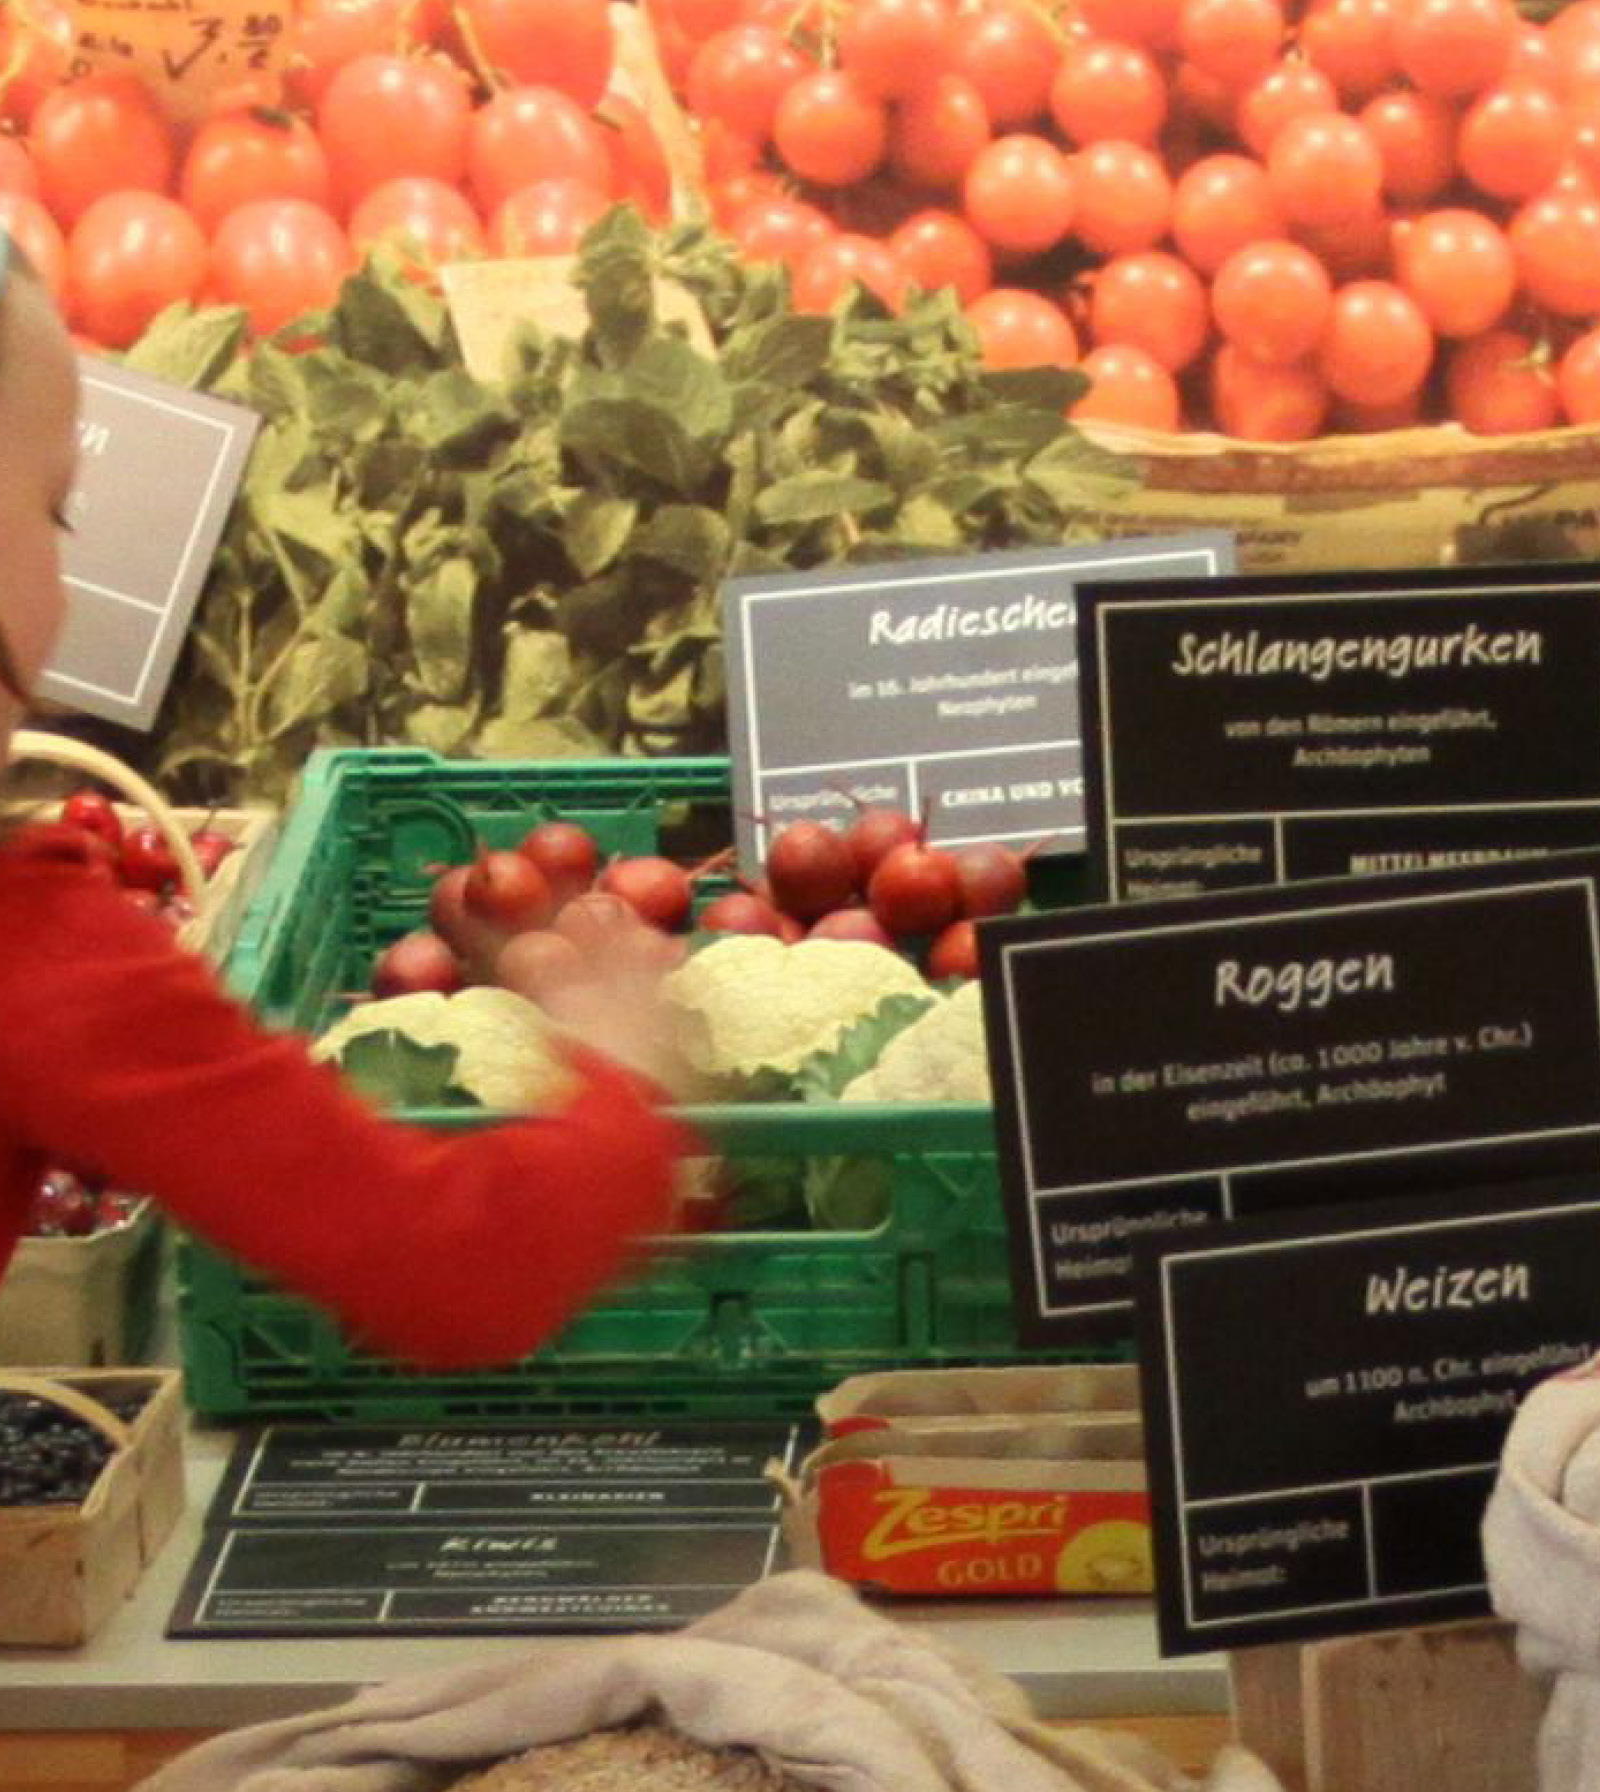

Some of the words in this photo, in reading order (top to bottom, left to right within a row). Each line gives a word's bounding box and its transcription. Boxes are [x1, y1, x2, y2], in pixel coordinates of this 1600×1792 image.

[869, 594, 1077, 646] Radiesche
[1171, 622, 1542, 682] Schlangengurken
[940, 784, 1005, 808] CHINA
[1009, 781, 1053, 802] UND
[1214, 951, 1395, 1013] Roggen
[1091, 1072, 1115, 1095] in
[1119, 1067, 1157, 1092] der
[1161, 1055, 1264, 1088] Eisenzeit
[1388, 1032, 1448, 1061] Jahre
[1364, 1260, 1531, 1316] Weizen
[862, 1486, 1071, 1561] Zespri
[937, 1553, 1043, 1589] GOLD
